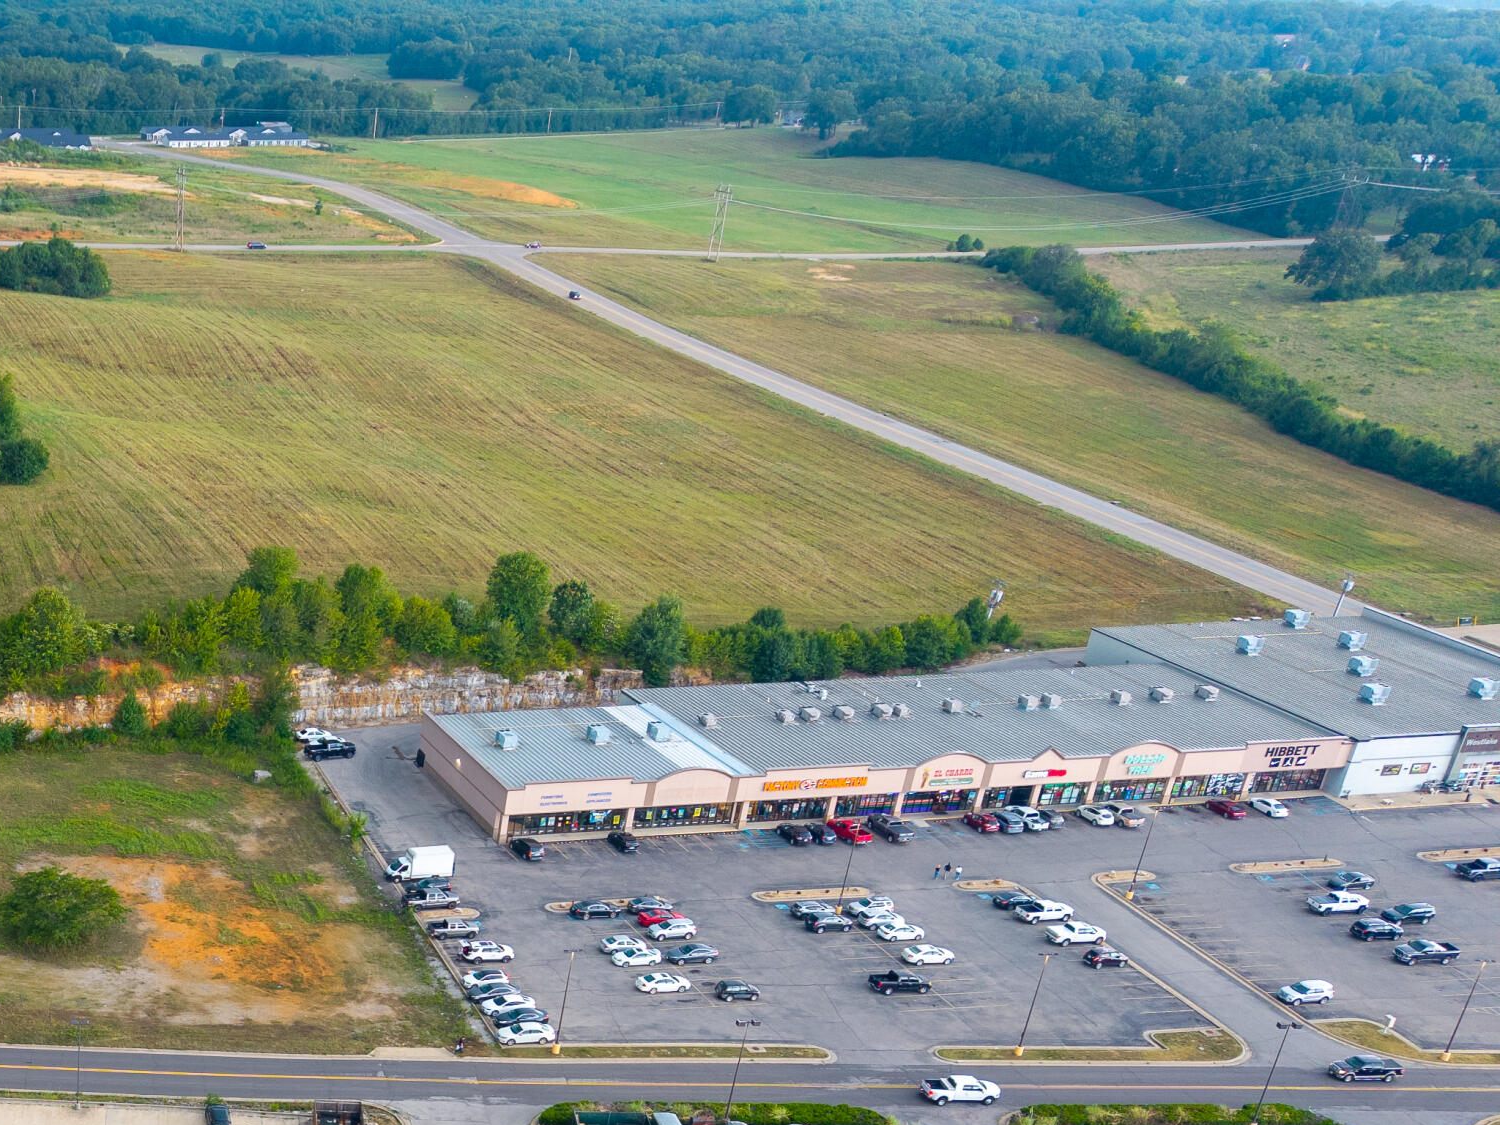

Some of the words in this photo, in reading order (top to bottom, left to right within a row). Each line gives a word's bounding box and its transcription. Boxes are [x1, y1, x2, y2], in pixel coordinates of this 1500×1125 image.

[1264, 744, 1321, 757] HIBBETT
[1124, 754, 1166, 765] DOLLAR
[1127, 765, 1154, 775] TREE
[763, 780, 800, 792] FACTORY
